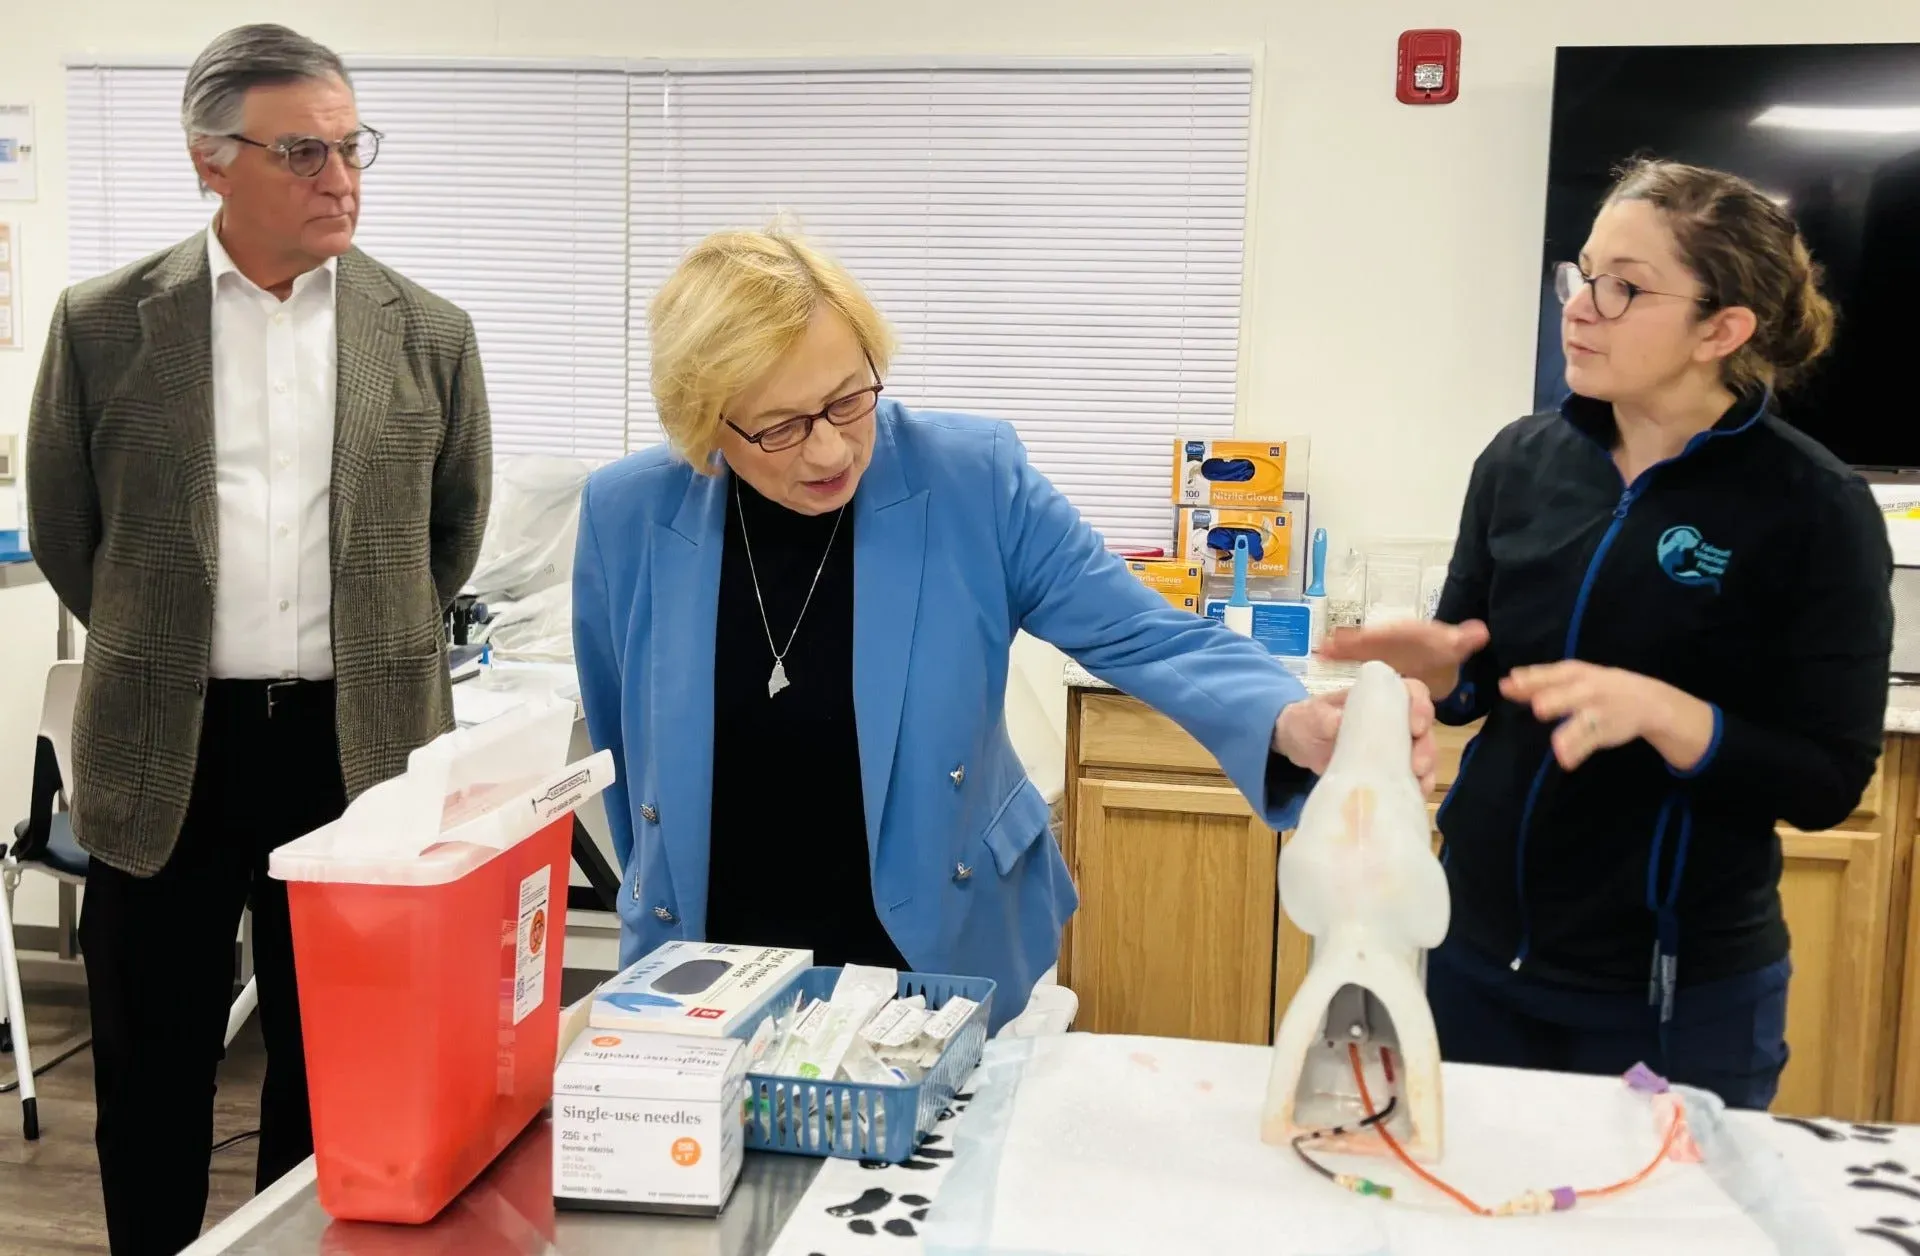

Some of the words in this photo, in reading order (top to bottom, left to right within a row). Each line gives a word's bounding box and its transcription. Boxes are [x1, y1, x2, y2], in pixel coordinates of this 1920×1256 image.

[1271, 447, 1279, 455] XL
[1185, 490, 1200, 498] 100
[1213, 491, 1244, 501] Nitrile
[1246, 492, 1279, 503] Gloves
[1251, 561, 1284, 571] Gloves
[563, 1105, 639, 1123] Single-use
[644, 1110, 701, 1125] needles
[562, 1130, 580, 1141] 25G
